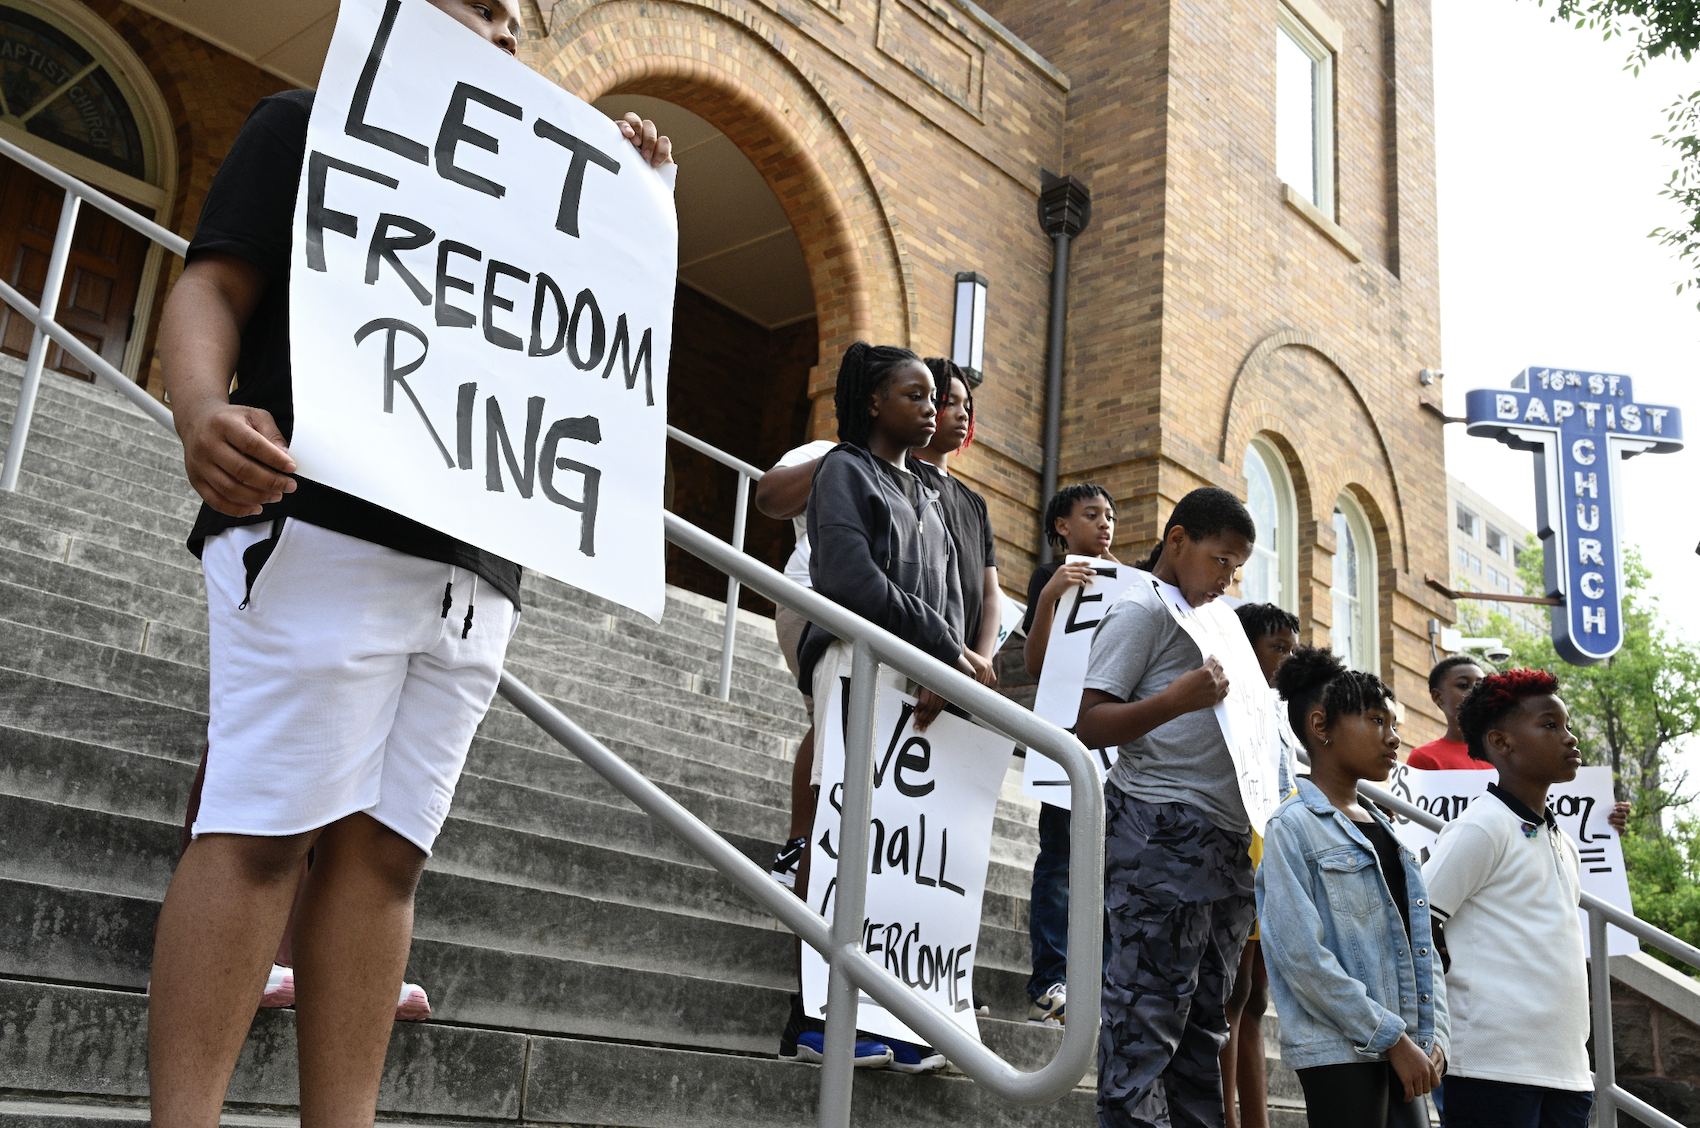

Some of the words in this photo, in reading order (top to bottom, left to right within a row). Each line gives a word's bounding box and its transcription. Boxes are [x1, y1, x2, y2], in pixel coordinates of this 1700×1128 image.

[0, 39, 71, 84] APTIST
[68, 85, 111, 149] CHURCH
[344, 0, 621, 239] LET
[305, 149, 655, 406] FREEDOM
[353, 317, 602, 557] RING
[1495, 393, 1669, 434] BAPTIST
[1587, 374, 1625, 398] ST.
[1572, 438, 1607, 635] CHURCH
[820, 877, 972, 1013] ERCOME
